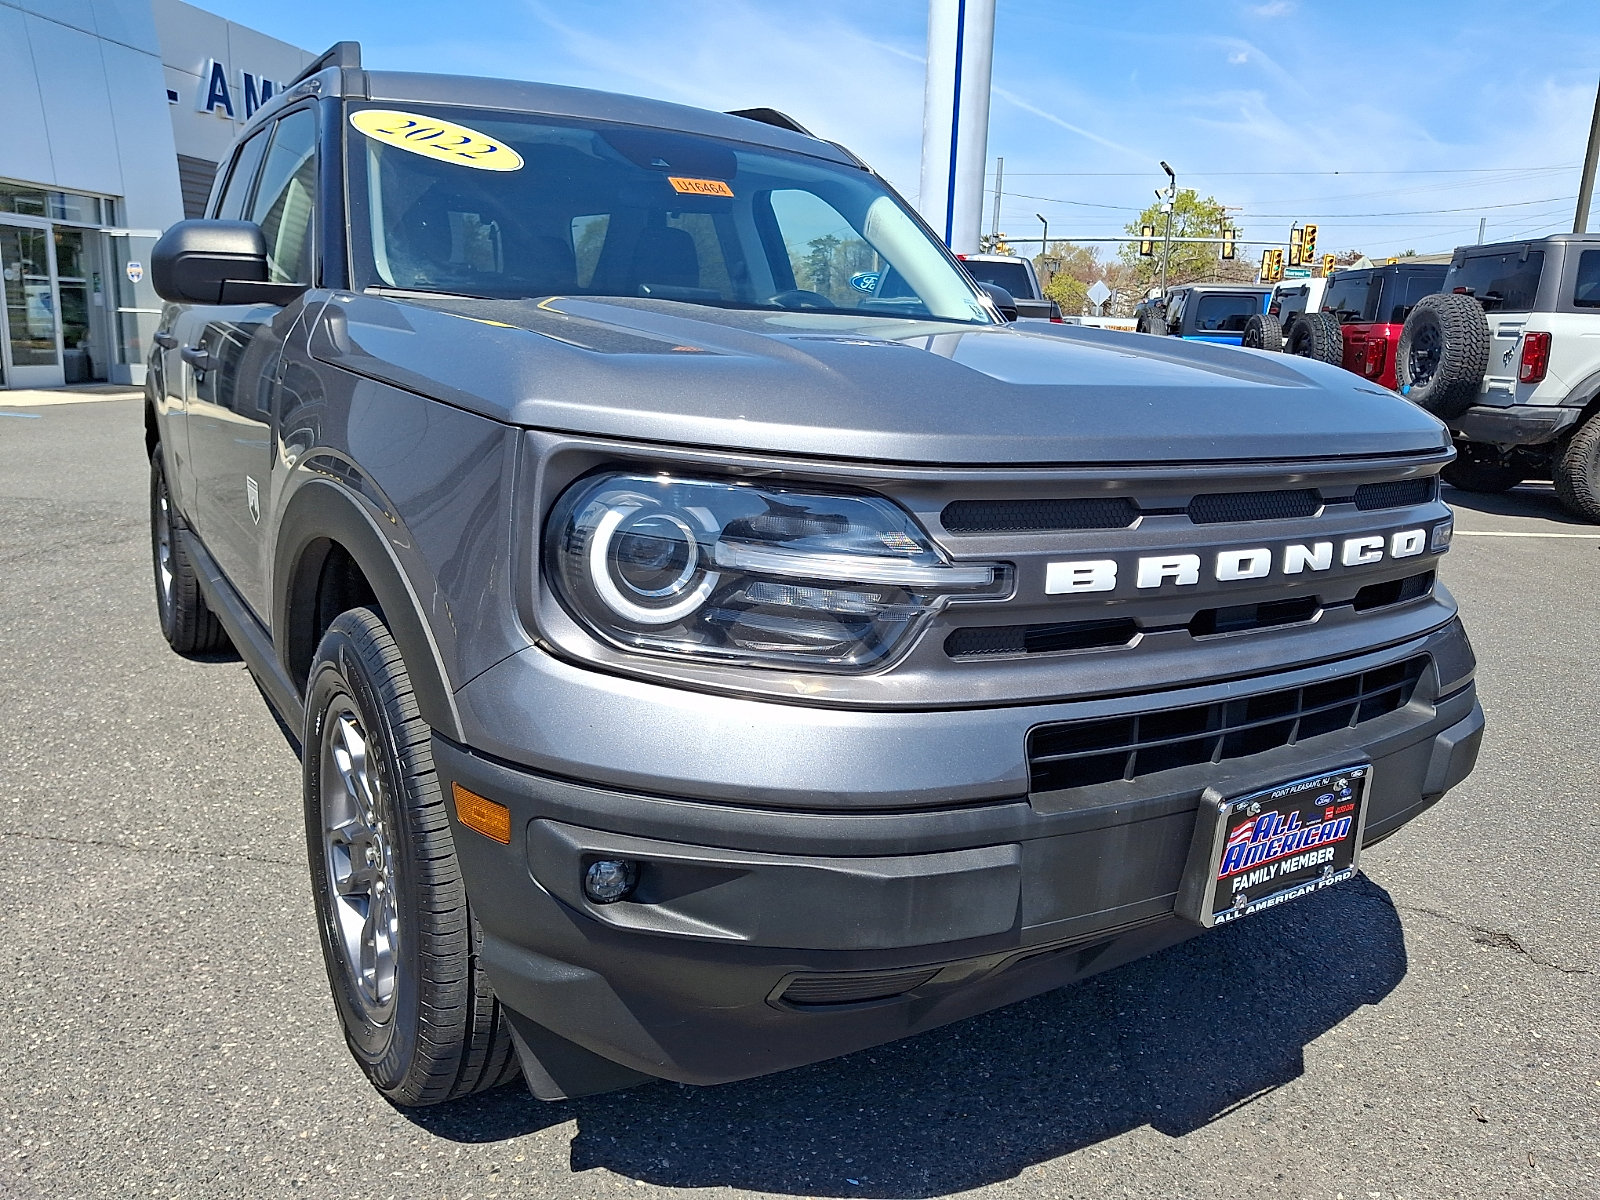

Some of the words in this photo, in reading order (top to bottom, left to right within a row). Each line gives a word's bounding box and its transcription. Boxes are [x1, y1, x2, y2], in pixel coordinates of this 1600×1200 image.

[197, 57, 287, 125] AM
[375, 120, 498, 160] 2022
[676, 180, 727, 194] U16464
[1045, 529, 1427, 595] BRONCO
[1271, 790, 1291, 799] POINT
[1321, 777, 1331, 785] NJ
[1316, 794, 1333, 805] Ford
[1219, 816, 1353, 877] AMERICAN
[1232, 863, 1279, 893] FAMILY
[1280, 846, 1335, 876] MEMBER
[1214, 909, 1242, 925] ALL
[1245, 884, 1315, 915] AMERICAN
[1318, 871, 1351, 889] FORD
